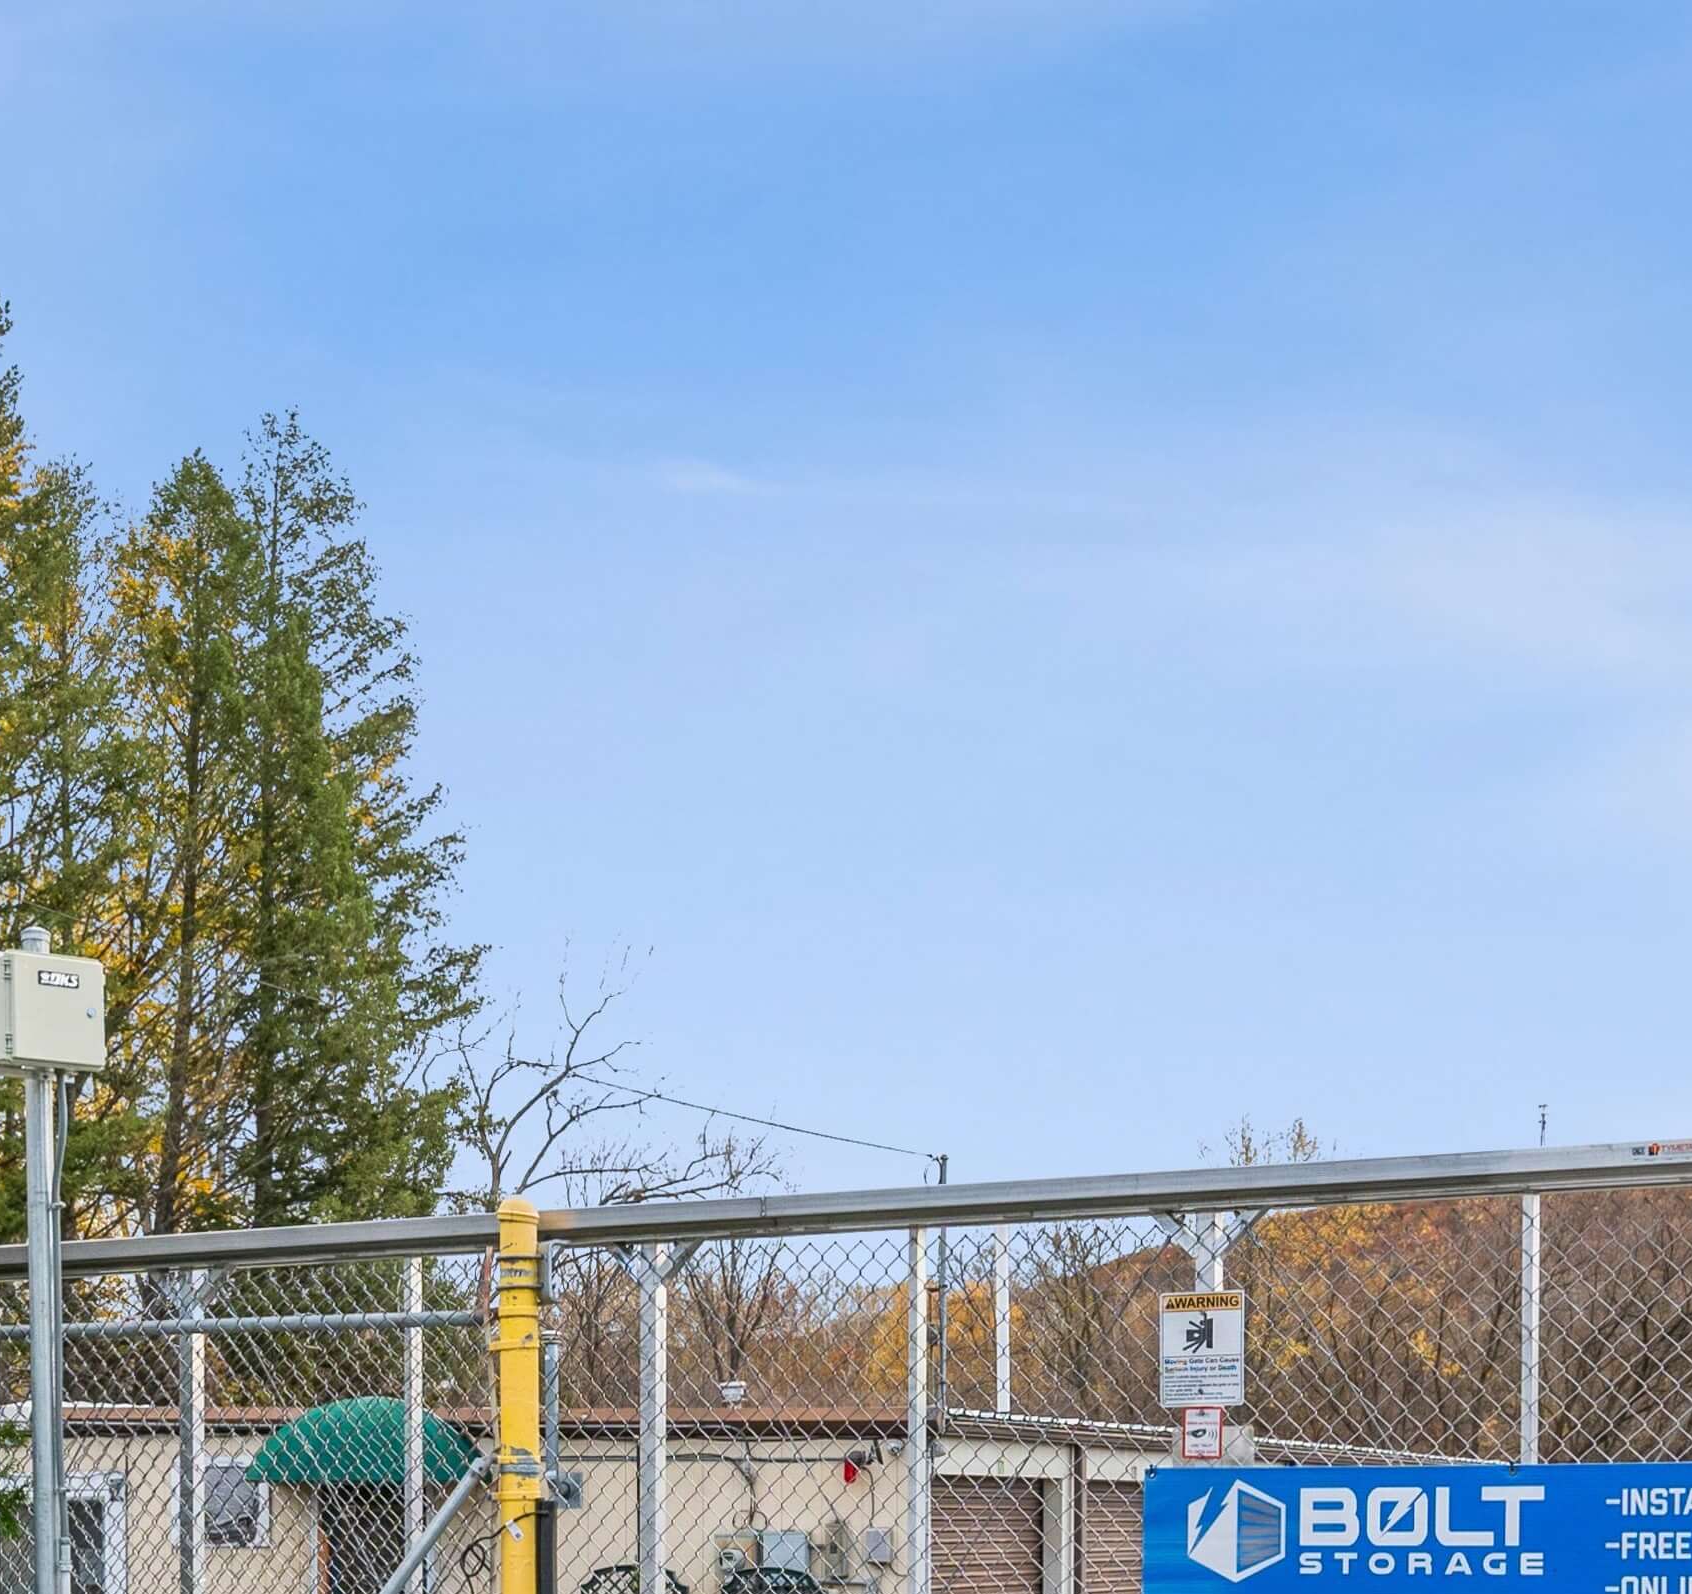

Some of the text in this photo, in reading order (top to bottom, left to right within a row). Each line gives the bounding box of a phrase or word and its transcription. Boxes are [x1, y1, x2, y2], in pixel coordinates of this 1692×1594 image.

[1174, 1295, 1240, 1309] WARNING
[1605, 1532, 1692, 1560] -FREE
[1299, 1551, 1545, 1576] STORAGE
